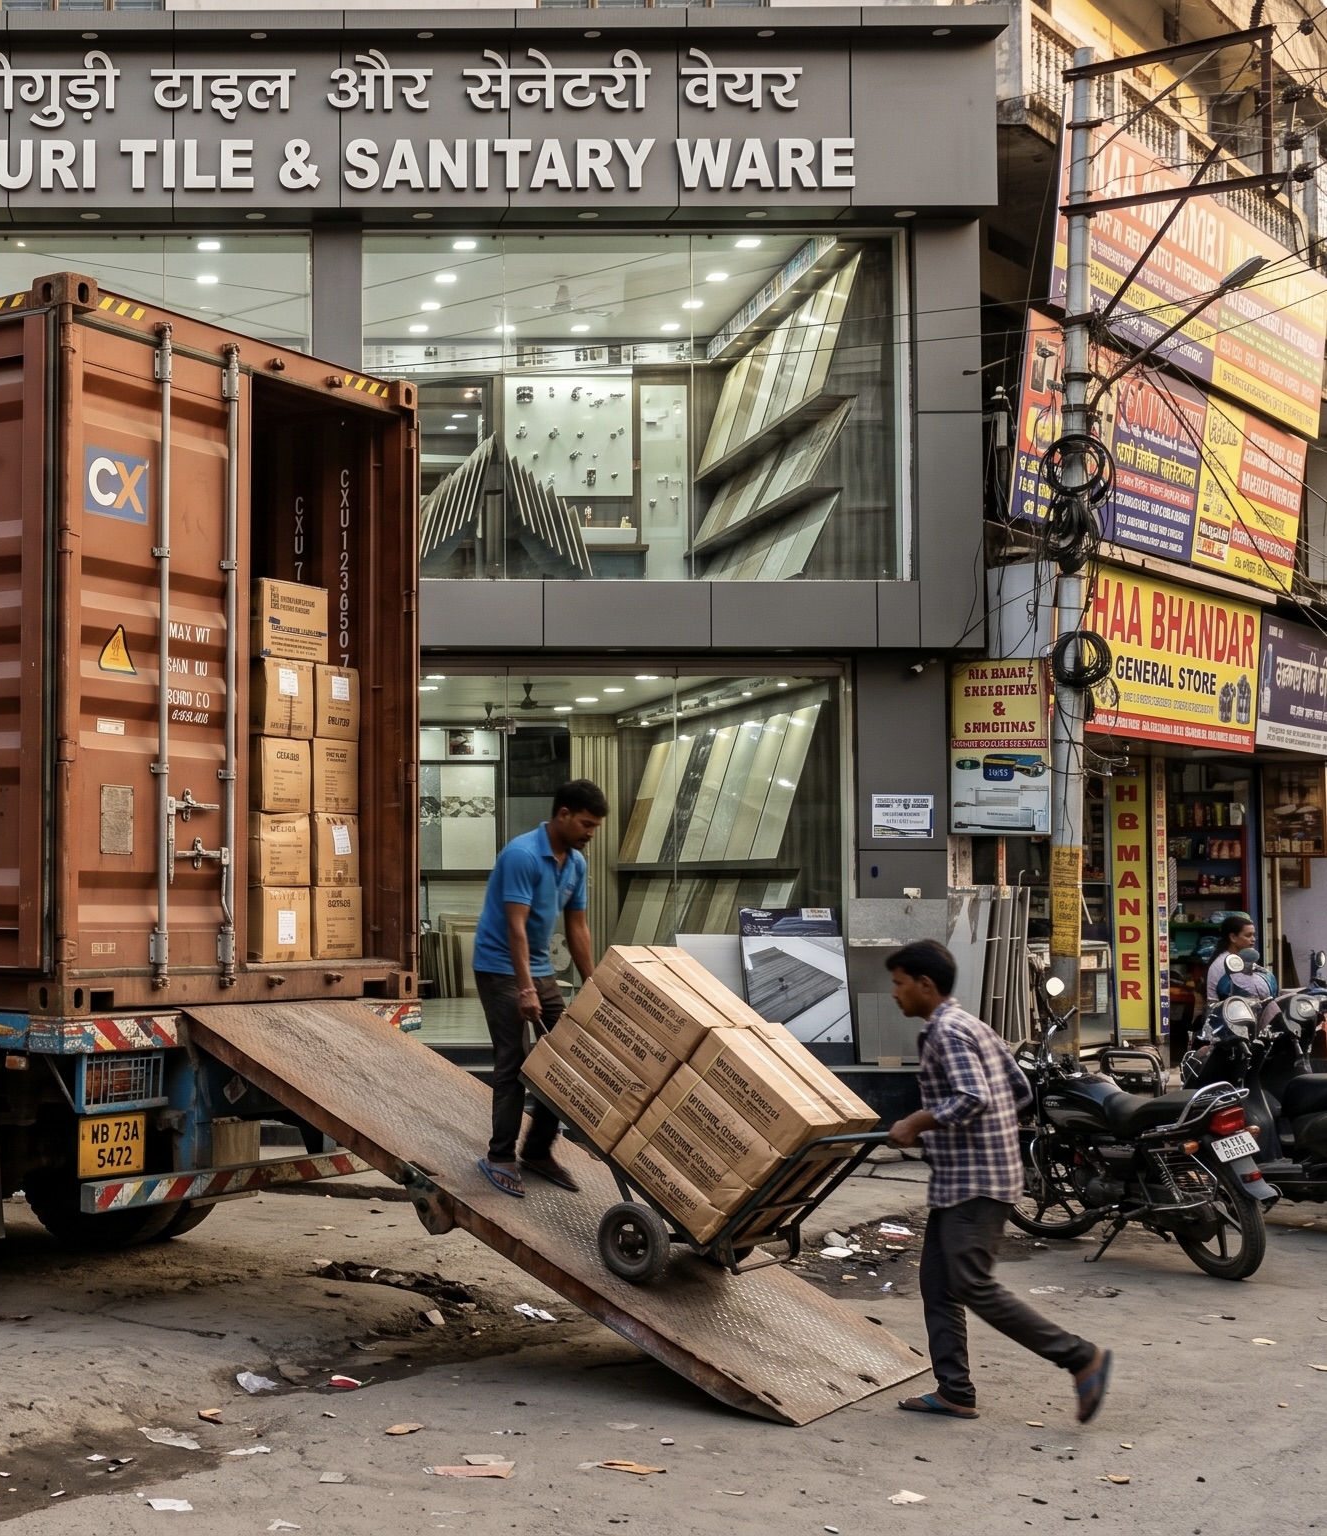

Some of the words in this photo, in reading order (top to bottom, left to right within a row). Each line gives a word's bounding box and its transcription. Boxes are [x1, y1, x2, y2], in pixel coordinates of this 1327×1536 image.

[150, 68, 296, 121] टाइल
[326, 48, 433, 110] और
[462, 48, 651, 110] सेनेटरी
[679, 48, 803, 110] वेयर
[120, 138, 255, 190] TILE
[278, 138, 321, 190] &
[344, 137, 656, 191] SANITARY
[676, 136, 856, 190] WARE
[88, 456, 146, 515] CX
[169, 622, 192, 641] MAX
[195, 627, 211, 643] WT
[1150, 590, 1255, 670] BHANDAR
[1115, 655, 1174, 689] GENERAL
[1178, 667, 1217, 696] STORE
[992, 701, 1006, 716] &
[113, 1120, 140, 1143] 73A
[97, 1145, 132, 1169] 5472
